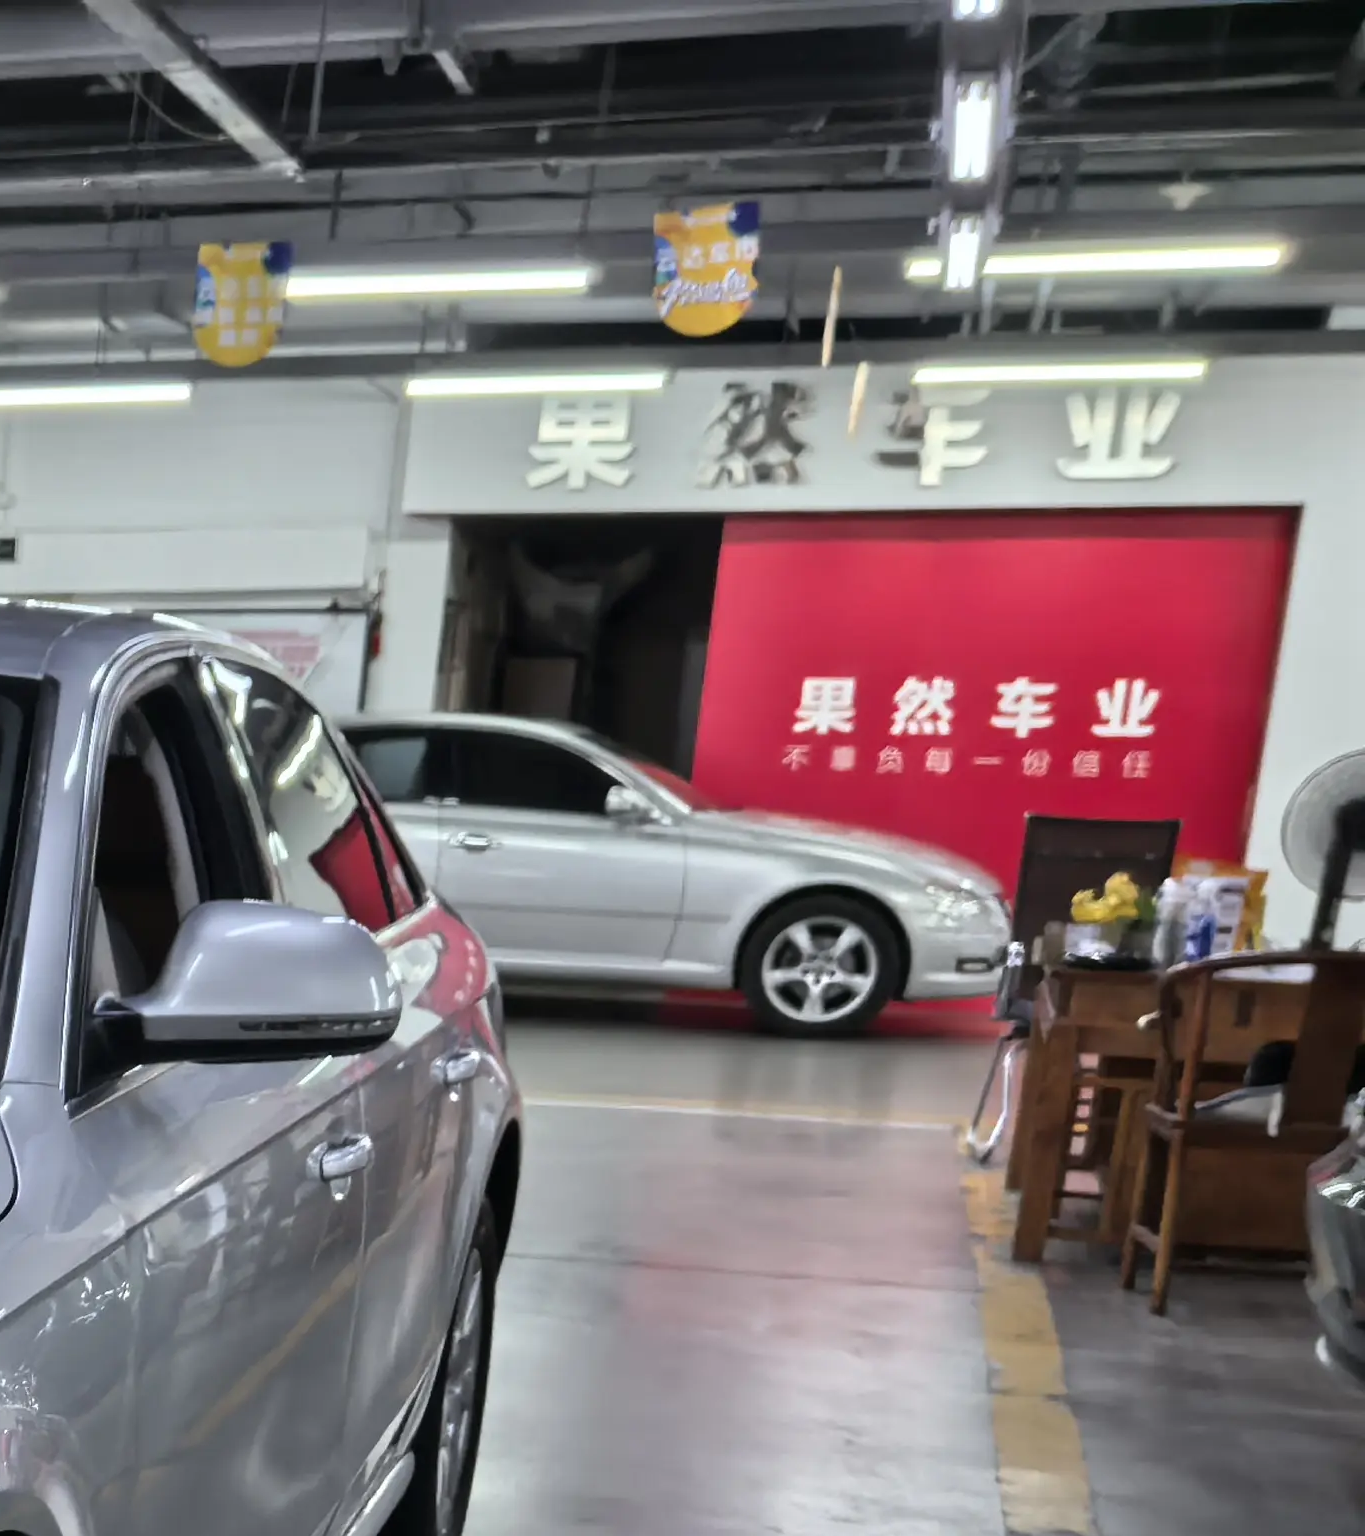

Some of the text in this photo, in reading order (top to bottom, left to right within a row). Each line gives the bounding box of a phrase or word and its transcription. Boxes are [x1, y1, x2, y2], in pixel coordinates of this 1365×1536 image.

[525, 382, 1183, 490] 果然车业
[791, 676, 1162, 740] 果然车业
